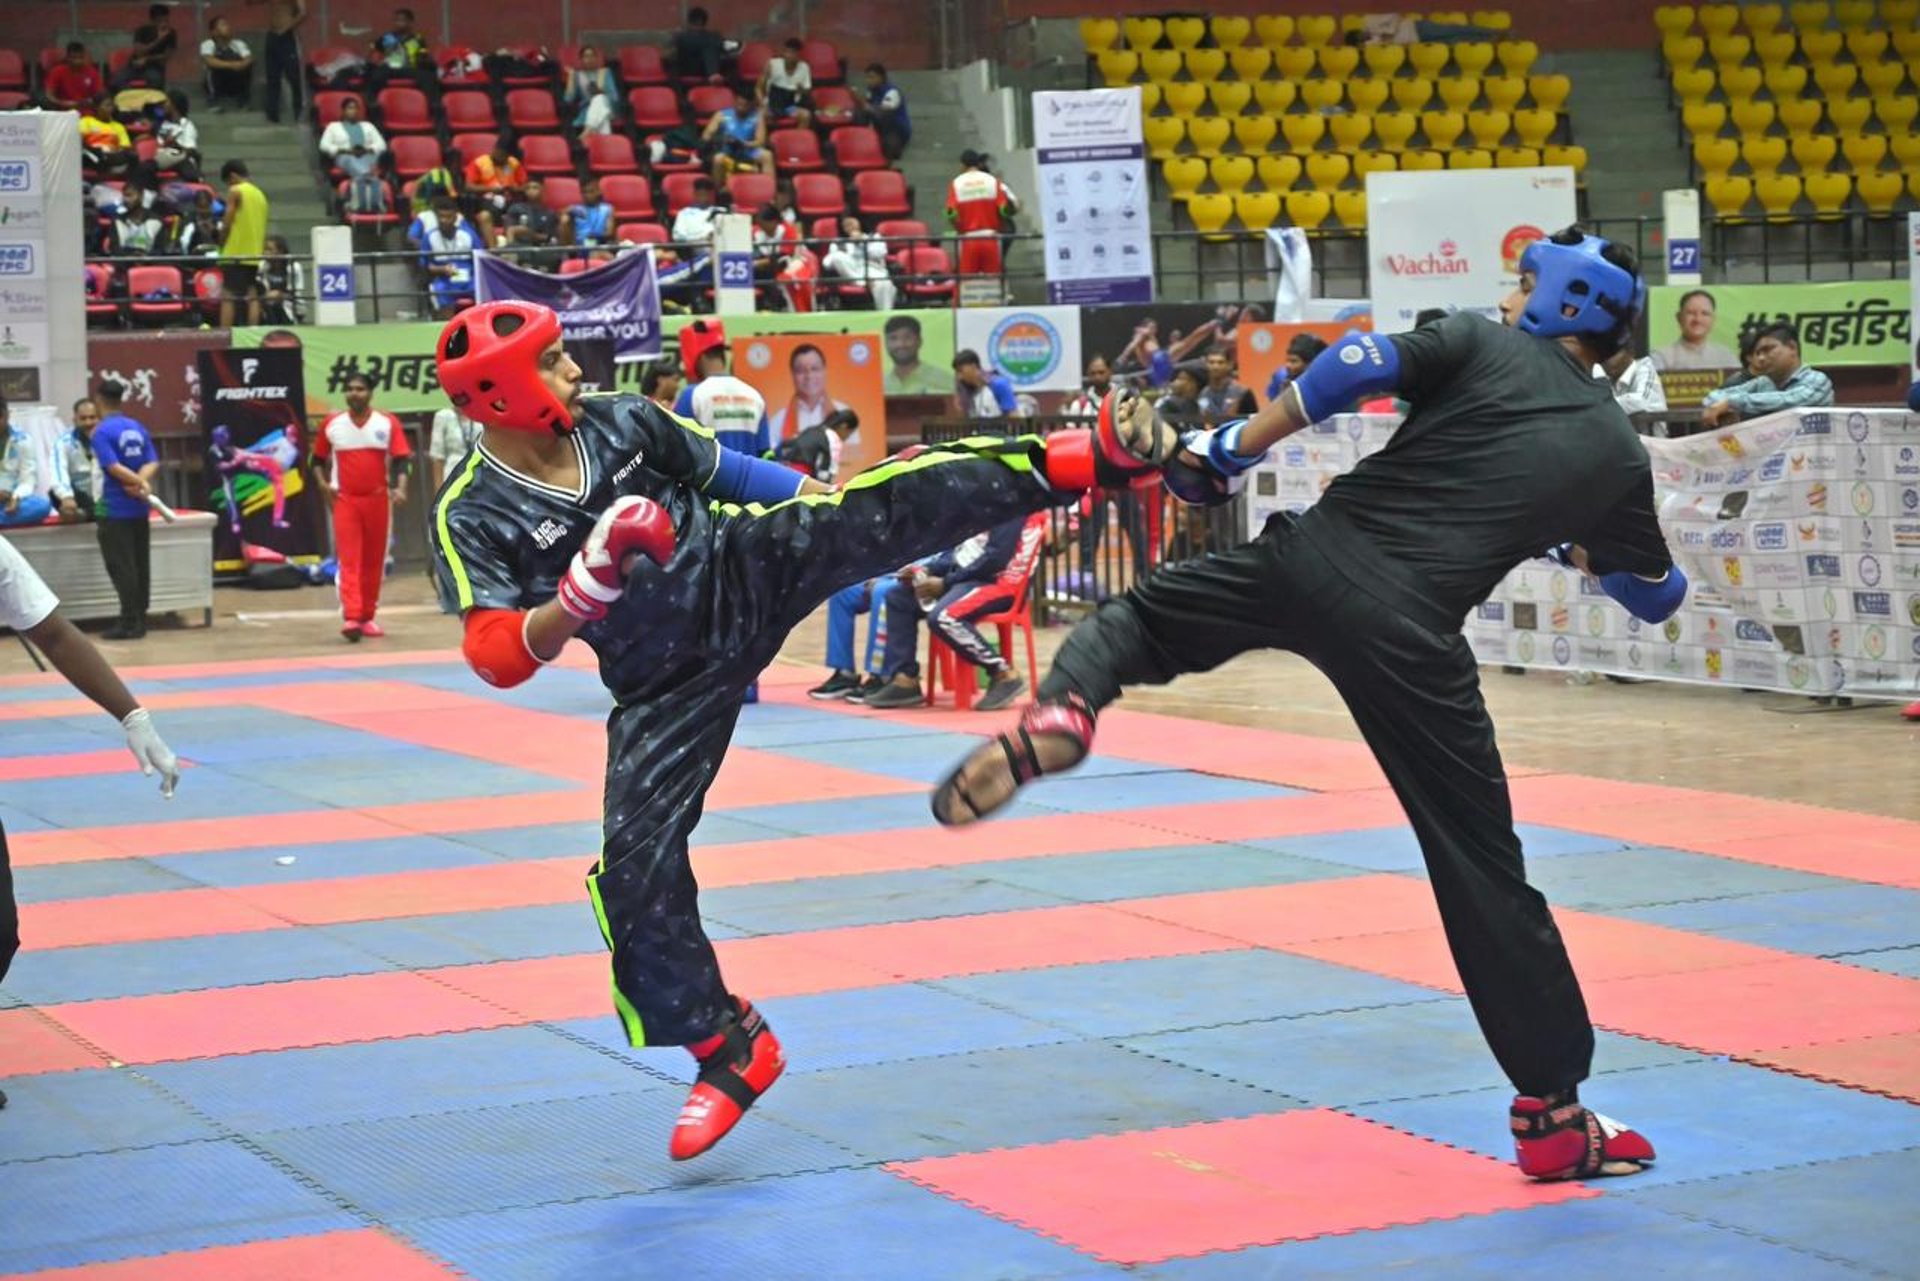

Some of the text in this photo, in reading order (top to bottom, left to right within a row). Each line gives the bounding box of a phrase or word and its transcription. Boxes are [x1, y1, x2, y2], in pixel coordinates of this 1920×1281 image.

[1385, 252, 1469, 276] Vachan
[1672, 248, 1695, 266] 27
[723, 261, 748, 280] 25
[322, 273, 348, 292] 24
[608, 320, 649, 340] YOU
[215, 386, 288, 400] FIGHTEX
